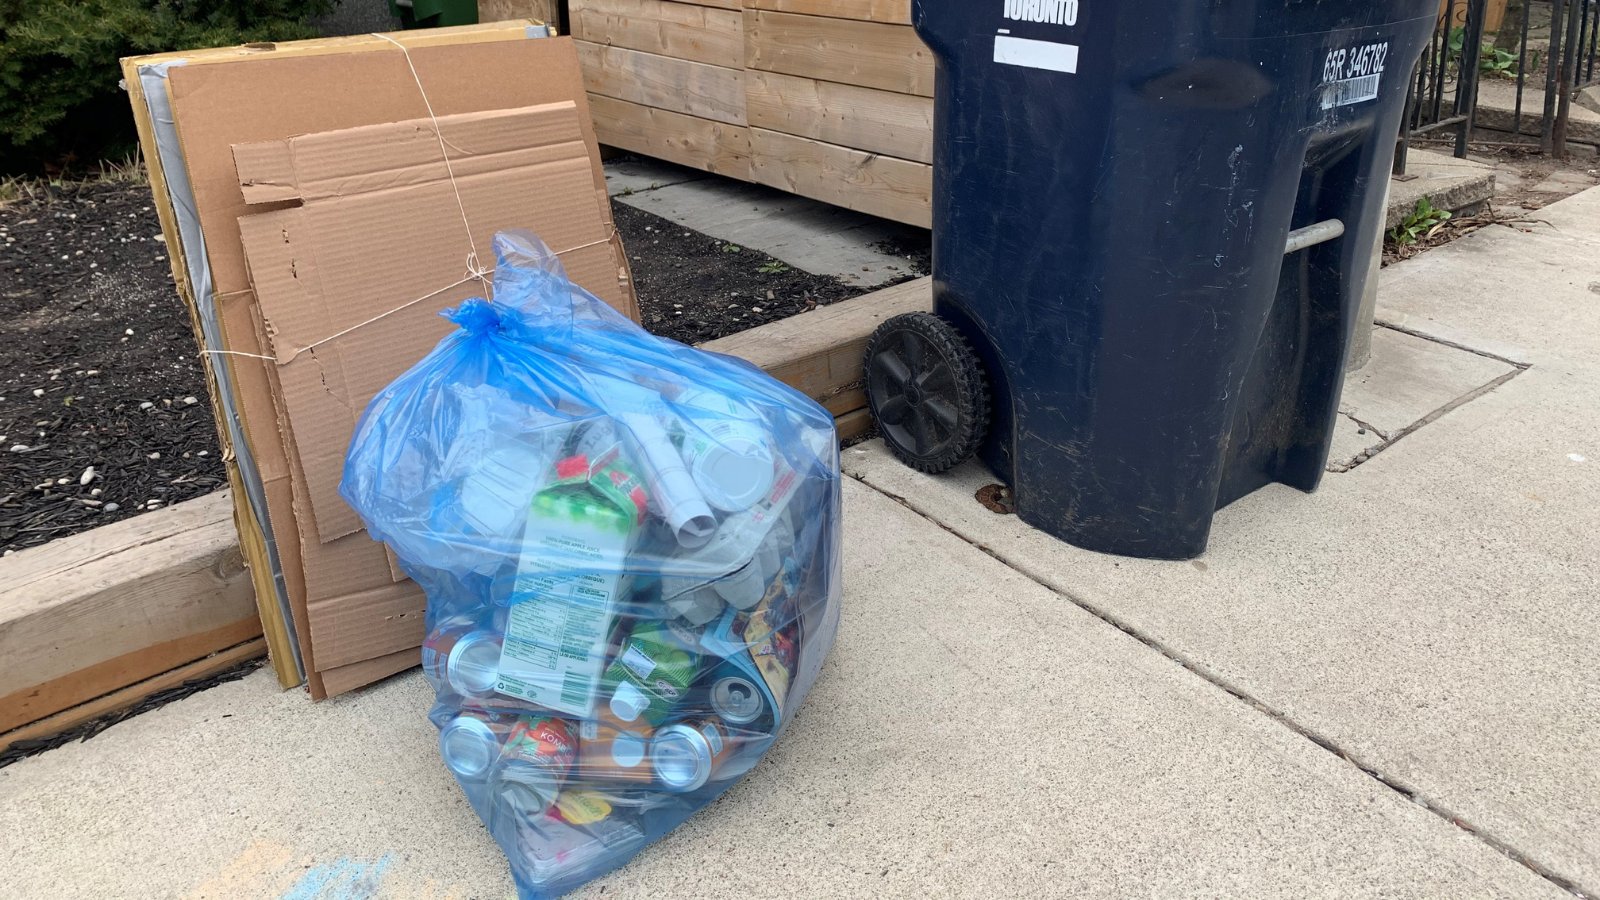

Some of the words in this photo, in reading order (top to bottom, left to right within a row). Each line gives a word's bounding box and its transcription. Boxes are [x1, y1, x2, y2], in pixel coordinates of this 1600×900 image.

[1003, 0, 1079, 26] TORONTO
[1323, 48, 1346, 82] 65R
[1347, 41, 1388, 78] 346782
